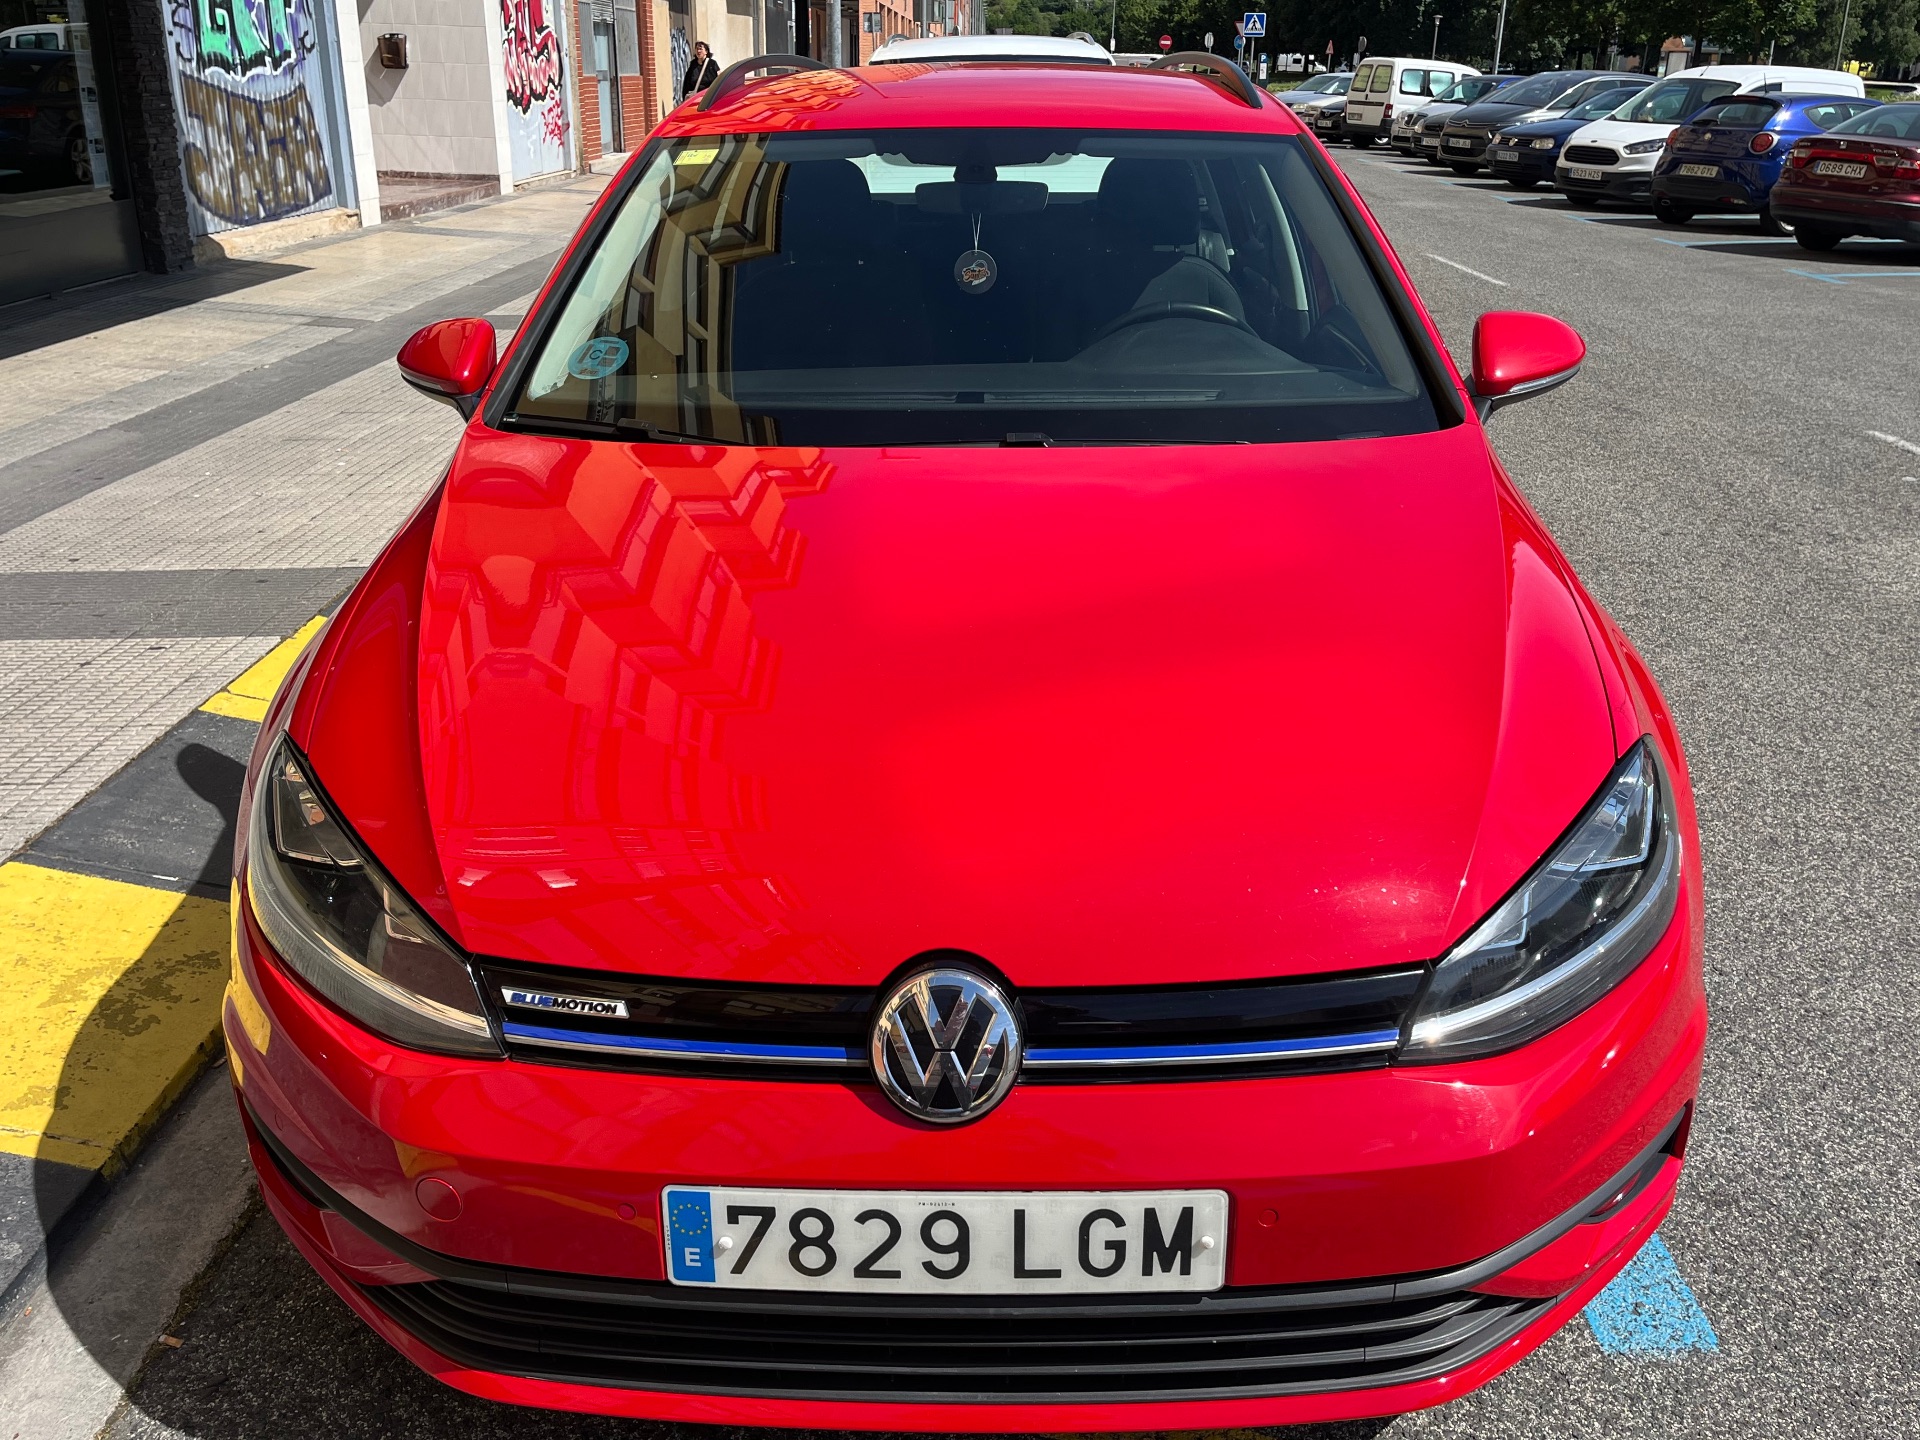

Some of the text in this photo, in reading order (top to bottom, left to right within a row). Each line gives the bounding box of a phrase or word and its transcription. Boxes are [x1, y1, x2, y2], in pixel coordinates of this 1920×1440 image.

[1572, 168, 1601, 179] 6523 HZS
[1700, 167, 1714, 176] GYL
[1819, 162, 1866, 176] 0689 CHX
[510, 992, 618, 1014] BLUEMOTION
[725, 1205, 1194, 1279] 7829 LGM
[684, 1247, 702, 1267] E
